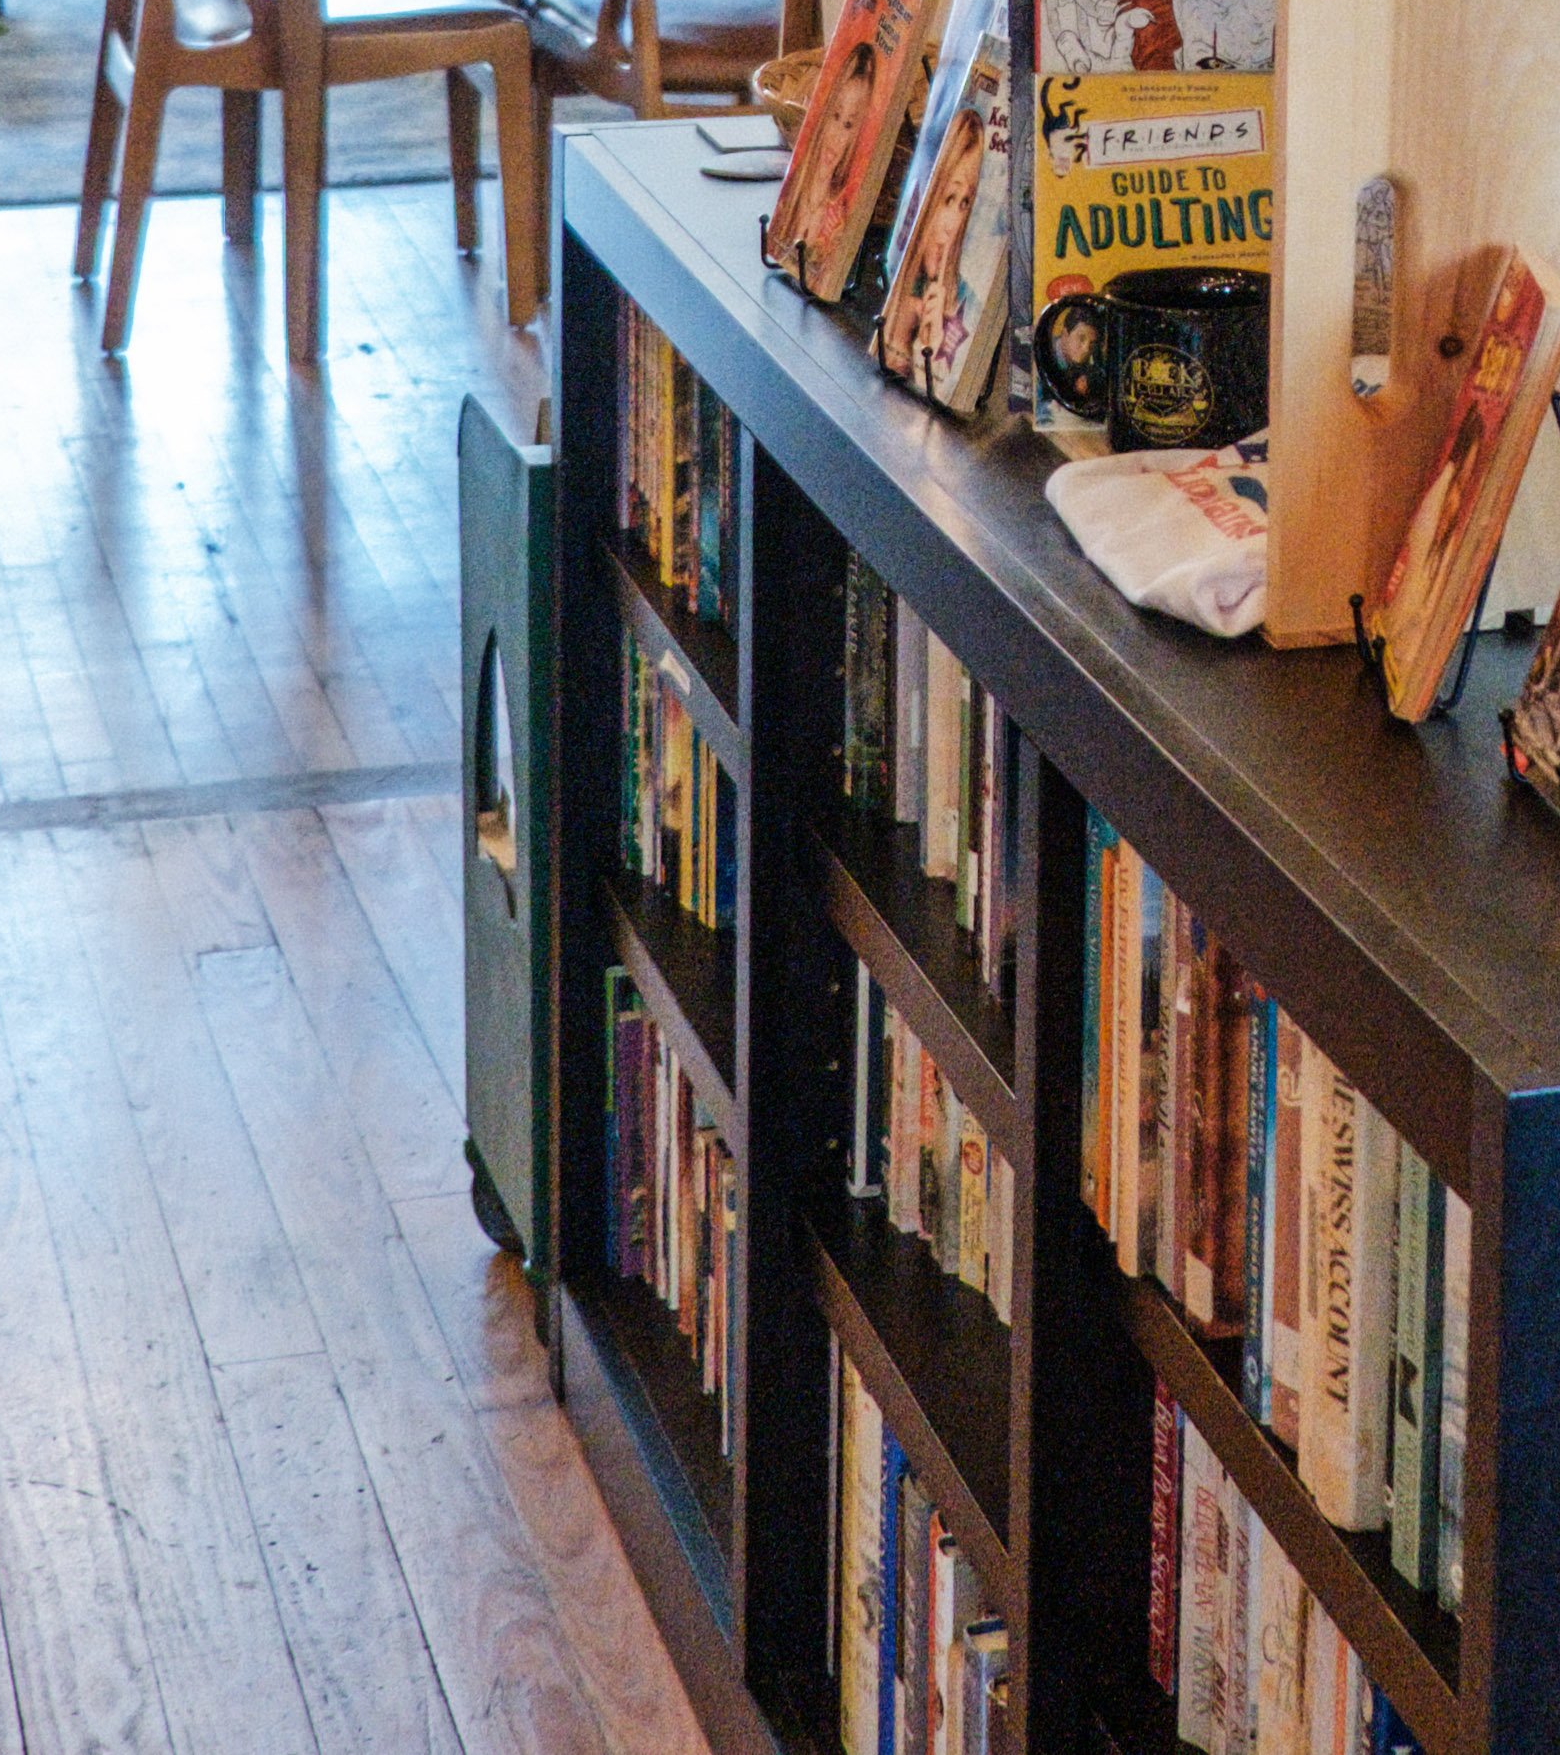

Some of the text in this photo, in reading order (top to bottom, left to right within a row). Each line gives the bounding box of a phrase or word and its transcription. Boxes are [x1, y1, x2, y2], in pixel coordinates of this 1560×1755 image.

[1111, 166, 1229, 197] GUIDE TO
[1055, 189, 1274, 259] ADULTING
[1321, 1123, 1356, 1413] SWISS ACCOUNT
